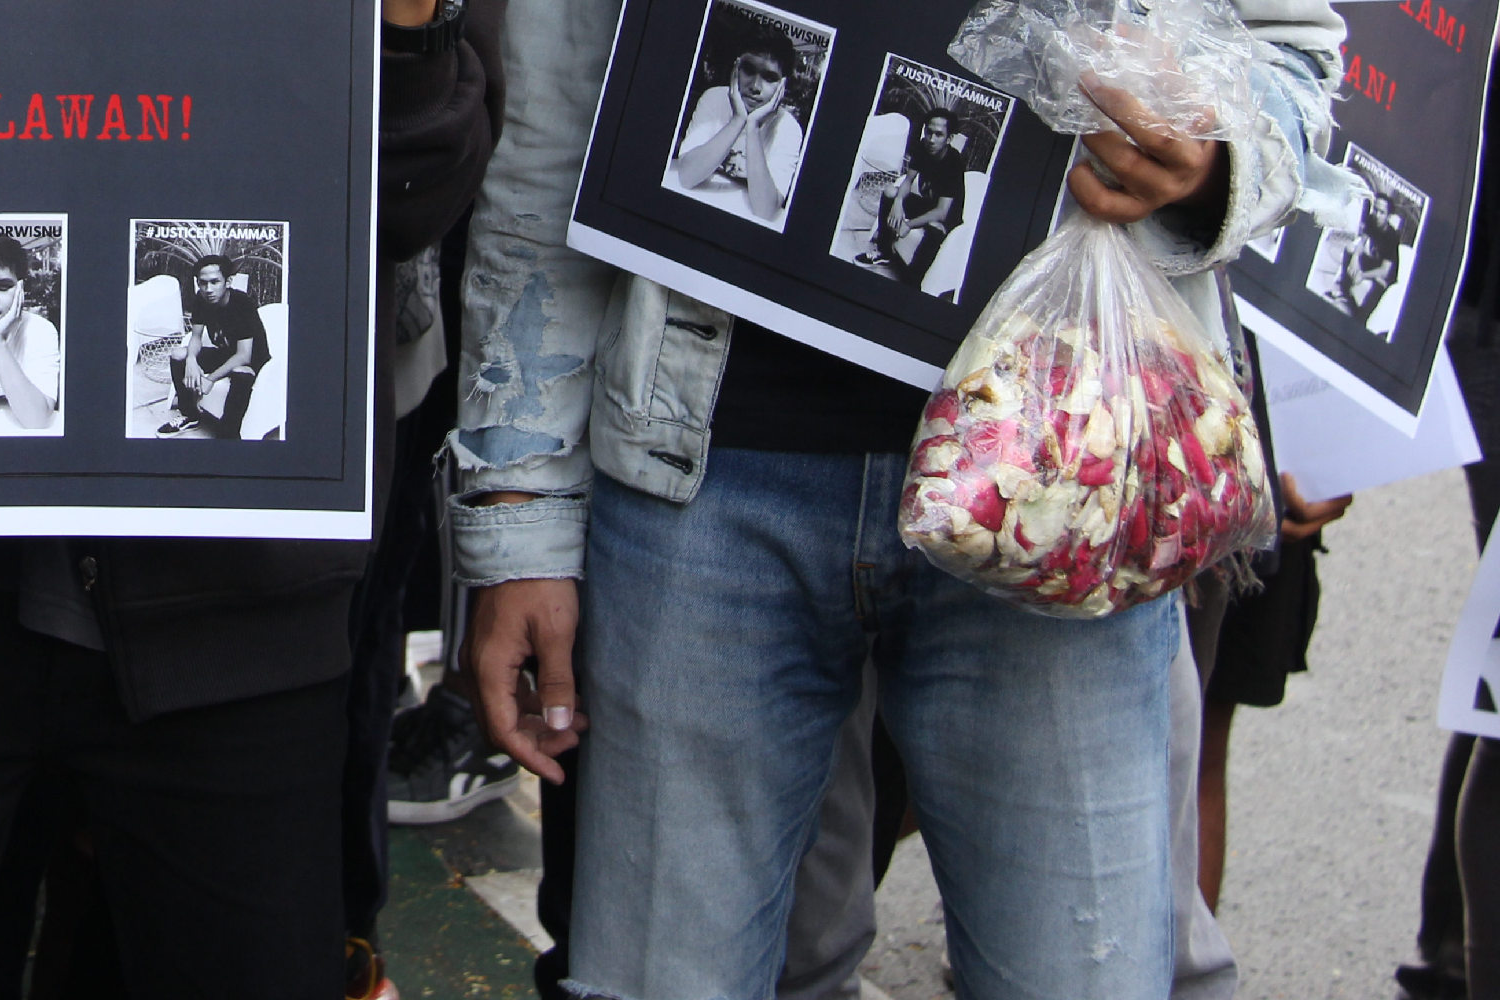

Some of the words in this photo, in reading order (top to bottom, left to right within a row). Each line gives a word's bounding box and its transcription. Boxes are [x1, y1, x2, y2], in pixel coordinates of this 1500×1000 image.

[714, 0, 831, 50] #JUSTICEFORWISNU
[895, 63, 1003, 113] #JUSTICEFORAMMAR
[1340, 44, 1398, 112] AN!
[146, 225, 278, 241] #JUSTICEFORAMMAR
